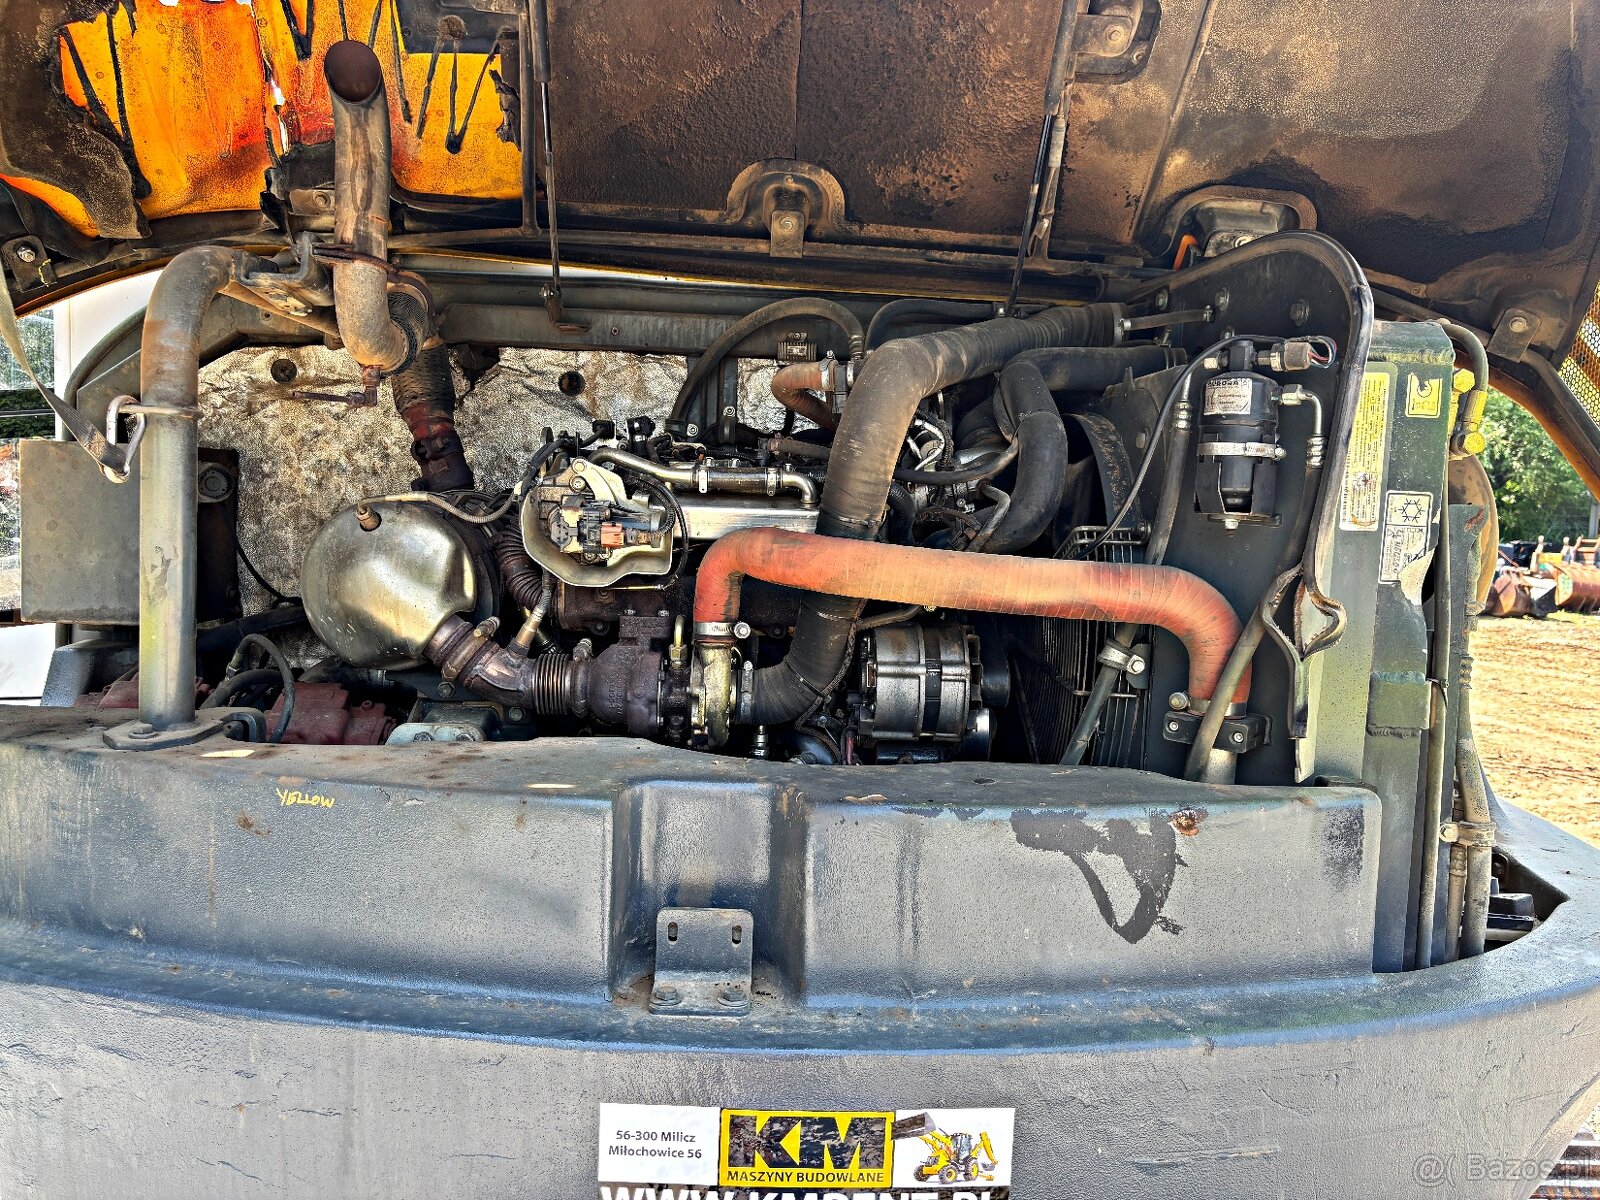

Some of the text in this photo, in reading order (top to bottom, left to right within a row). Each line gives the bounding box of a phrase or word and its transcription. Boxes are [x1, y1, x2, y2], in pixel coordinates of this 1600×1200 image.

[276, 787, 335, 808] YELLOW
[616, 1130, 695, 1143] 56-300 Milicz
[728, 1114, 886, 1169] KM
[608, 1145, 702, 1159] Miłochowice 56
[727, 1170, 884, 1183] MASZYNY BUDOWLANE
